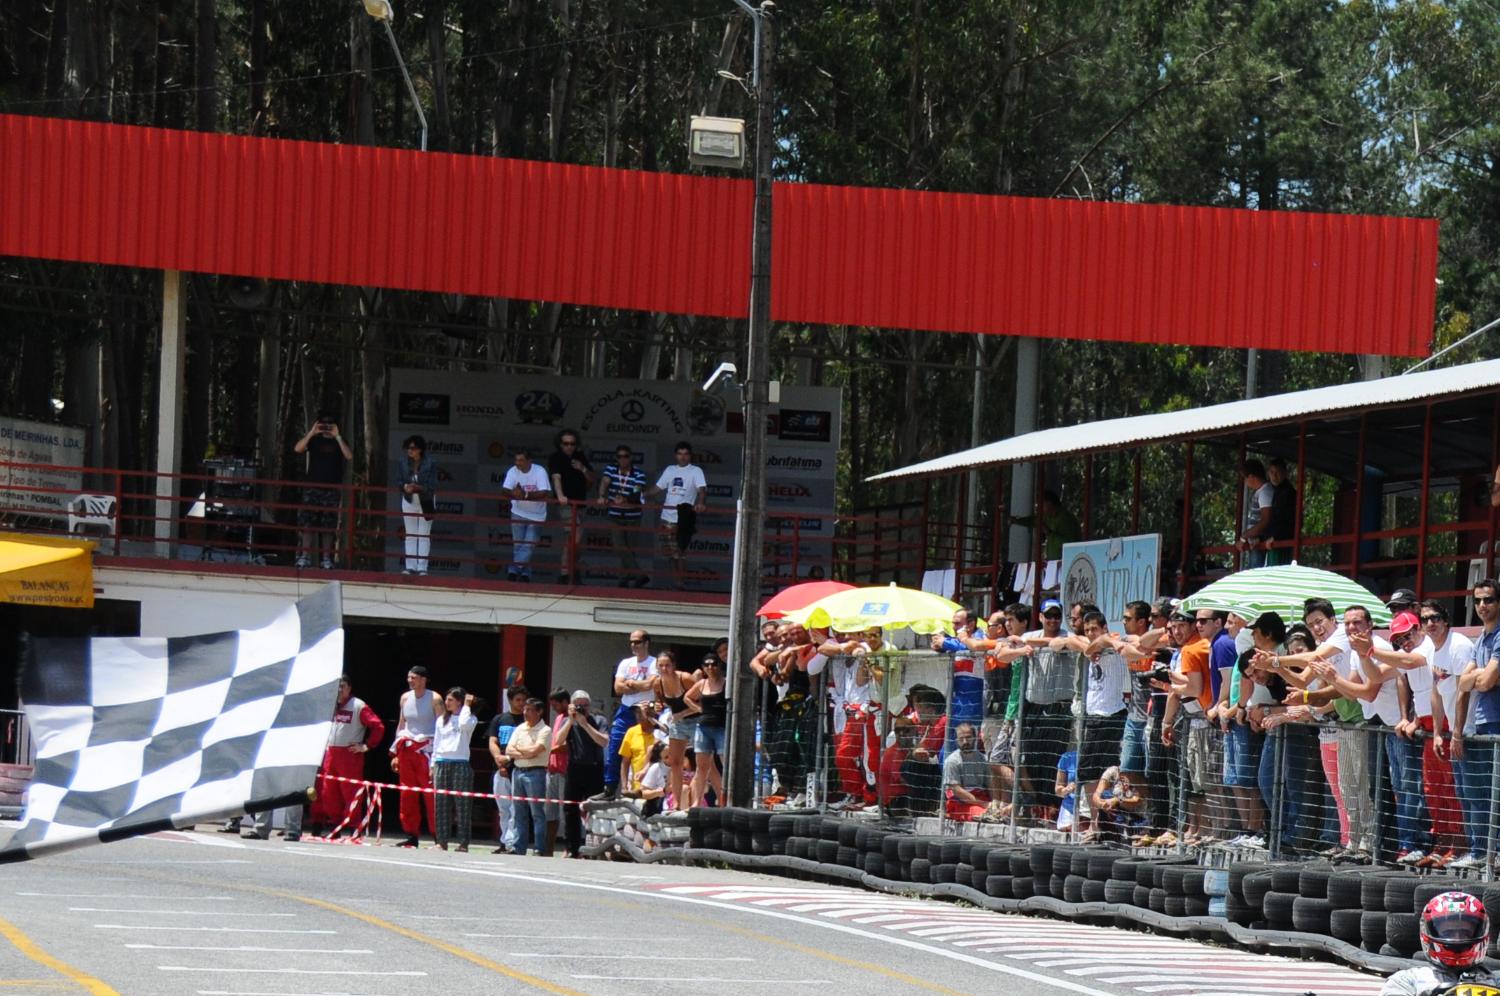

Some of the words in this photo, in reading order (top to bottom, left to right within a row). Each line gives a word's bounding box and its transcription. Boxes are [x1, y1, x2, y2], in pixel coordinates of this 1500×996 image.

[456, 404, 505, 416] HONDA
[580, 389, 625, 432] ESCOLA
[632, 388, 684, 434] KARTING
[606, 423, 661, 434] EUROINDY
[690, 452, 722, 464] ELIX
[768, 486, 811, 498] HELIX
[31, 494, 62, 506] POMBAL
